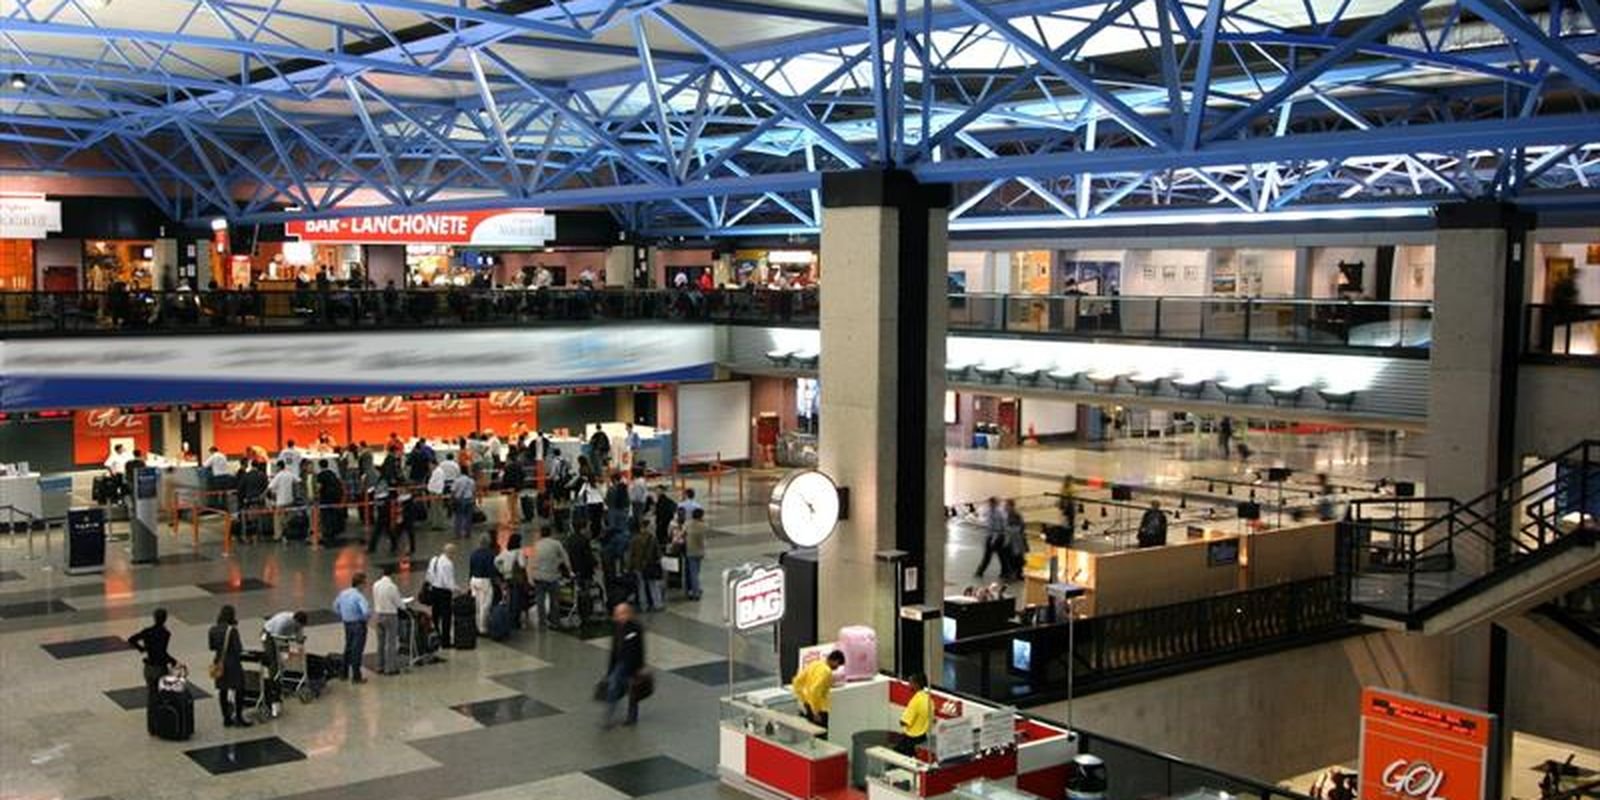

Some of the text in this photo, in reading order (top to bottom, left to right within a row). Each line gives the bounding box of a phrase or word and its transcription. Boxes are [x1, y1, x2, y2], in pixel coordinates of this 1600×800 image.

[305, 218, 339, 233] BAR
[351, 214, 468, 235] LANCHONETE
[739, 593, 782, 624] BAG
[1382, 758, 1447, 800] GOL
